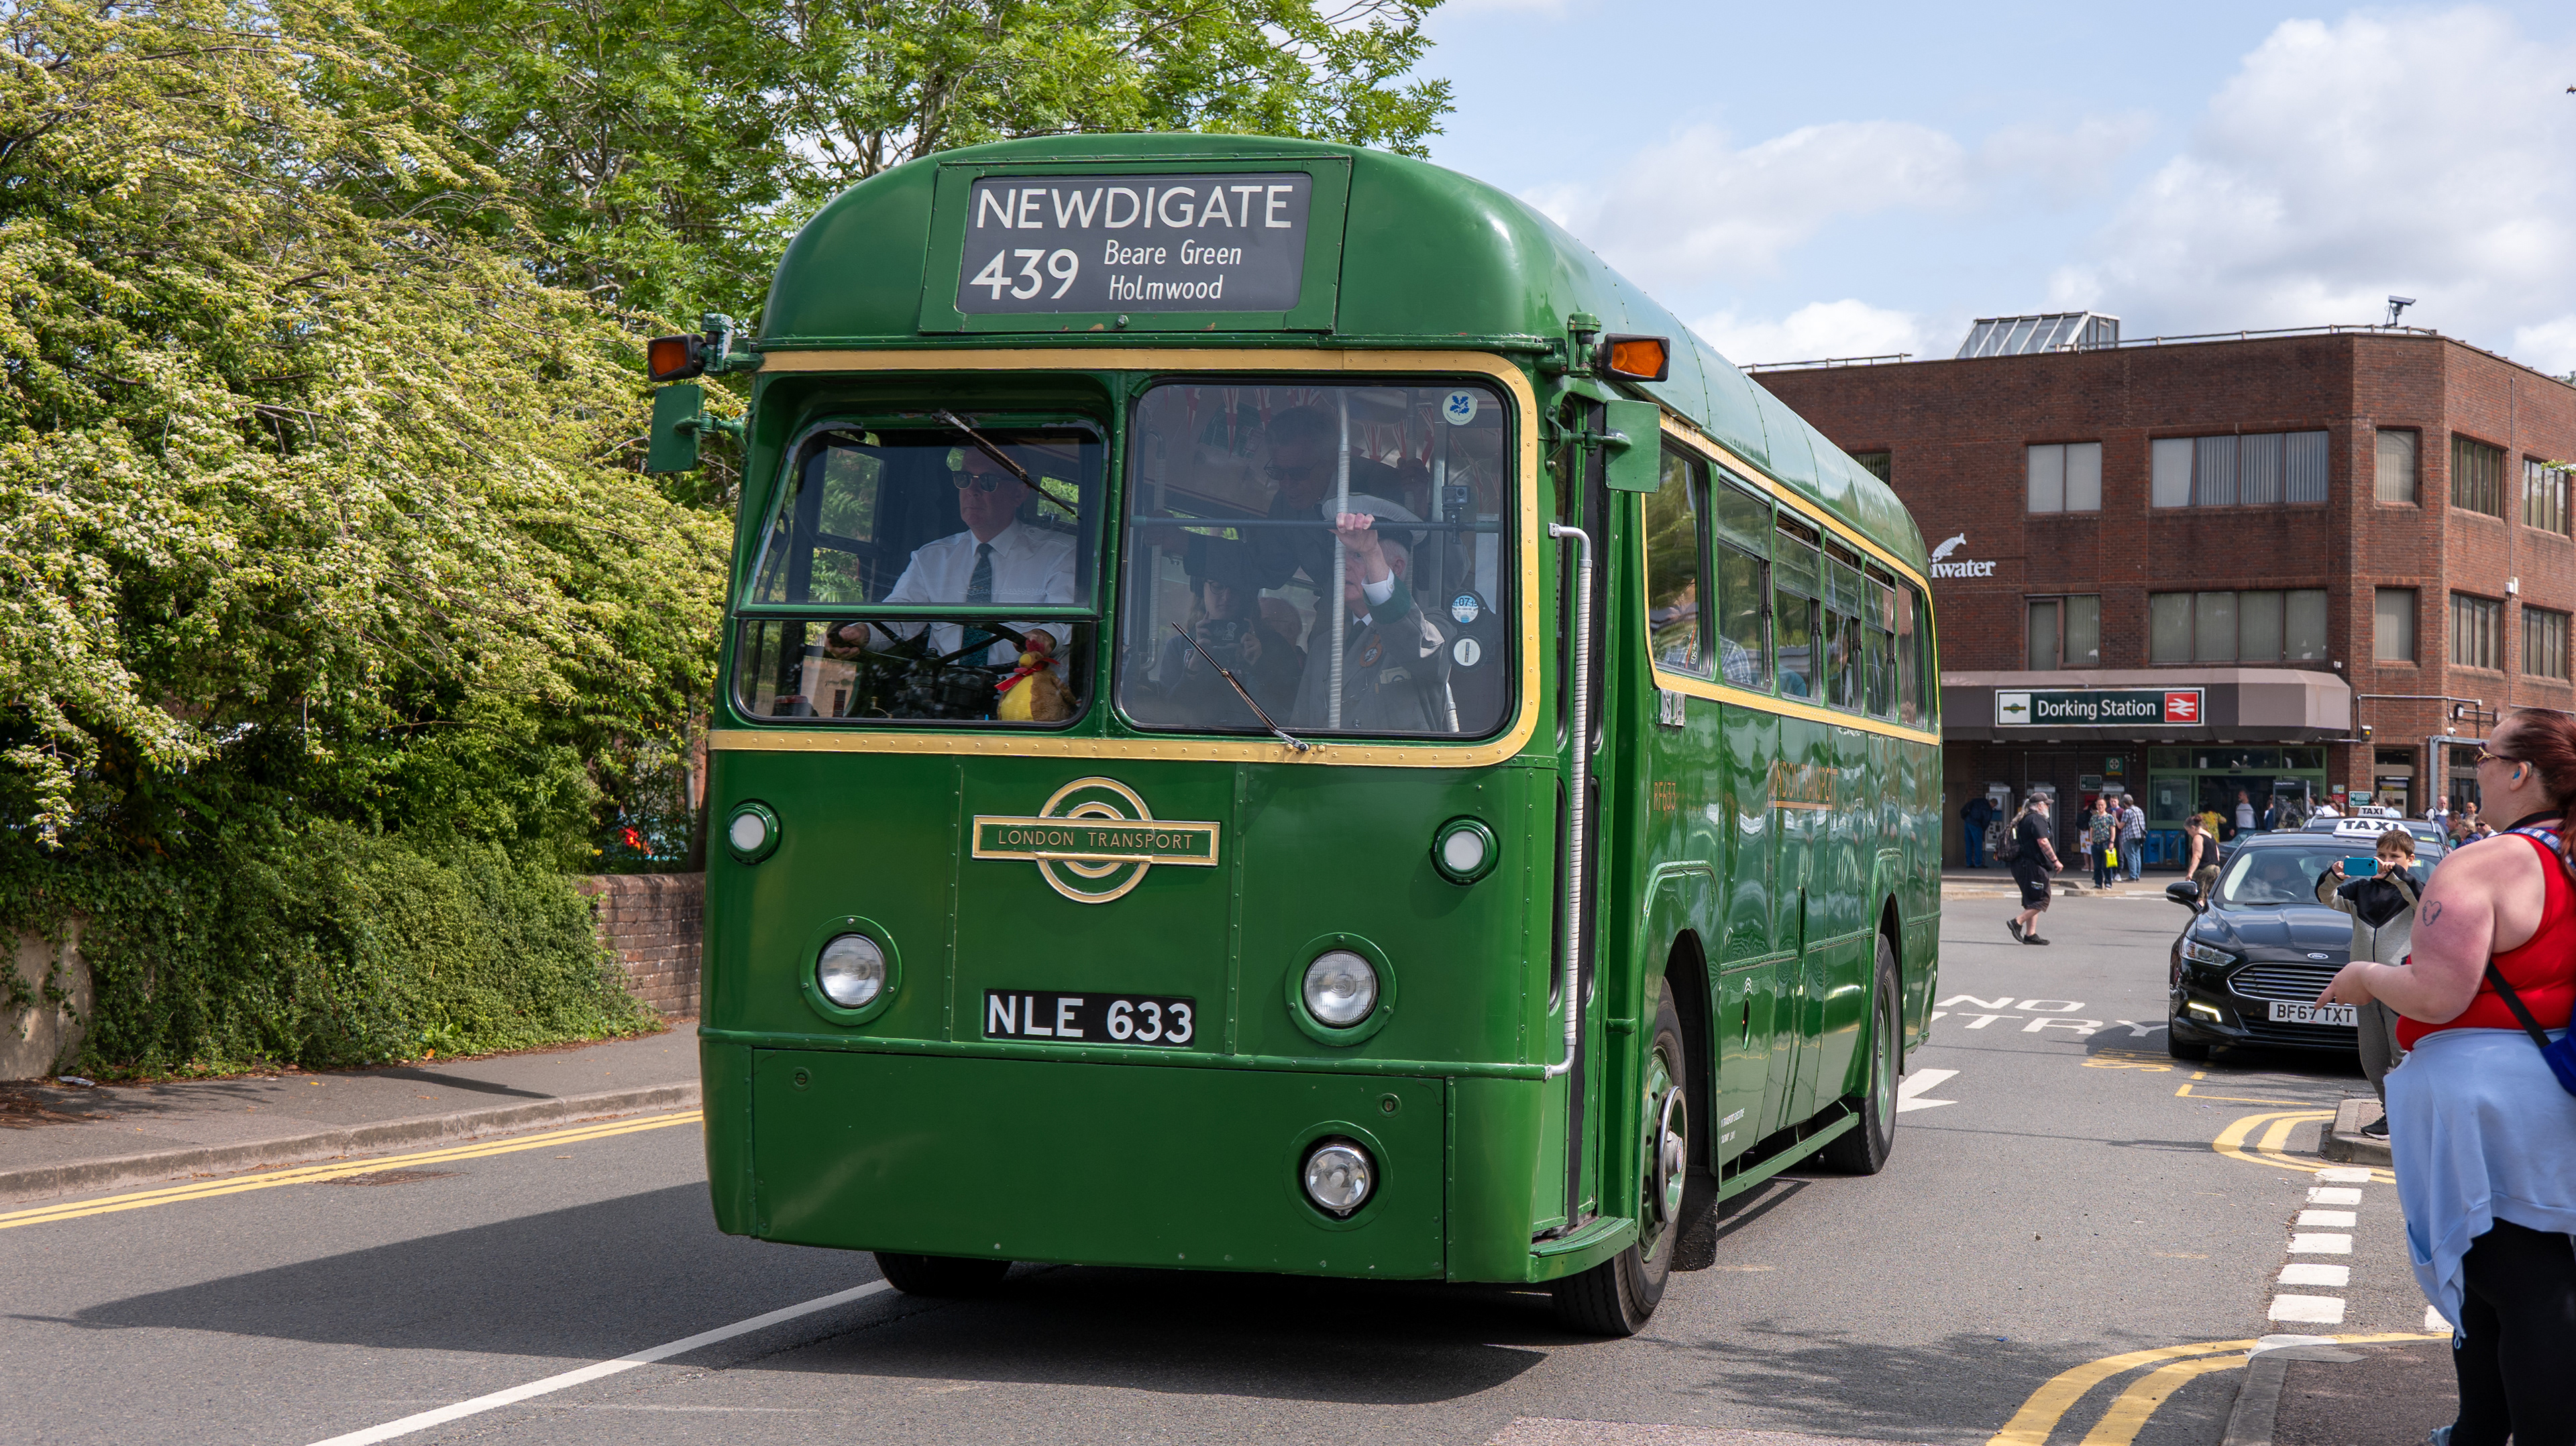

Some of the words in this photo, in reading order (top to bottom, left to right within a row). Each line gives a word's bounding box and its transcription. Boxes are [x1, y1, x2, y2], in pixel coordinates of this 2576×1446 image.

[976, 184, 1293, 229] NEWDIGATE
[1104, 239, 1167, 266] Beare
[1181, 239, 1242, 266] Green
[969, 248, 1079, 300] 439
[1108, 274, 1224, 301] Holmwood
[1928, 559, 1996, 578] iwater
[1458, 597, 1470, 607] 07
[2037, 700, 2098, 720] Dorking
[2101, 699, 2156, 716] Station
[1654, 781, 1676, 812] RF633
[1768, 759, 1799, 808] LONDON
[1801, 763, 1838, 811] TRANSPORT
[2343, 820, 2399, 831] TAXI
[998, 830, 1073, 846] LONDON
[1087, 832, 1193, 849] TRANSPORT
[1935, 995, 2086, 1012] NO
[2276, 1003, 2318, 1020] BF67
[2323, 1007, 2353, 1023] TXT
[988, 995, 1084, 1038] NLE
[1107, 1000, 1193, 1044] 633
